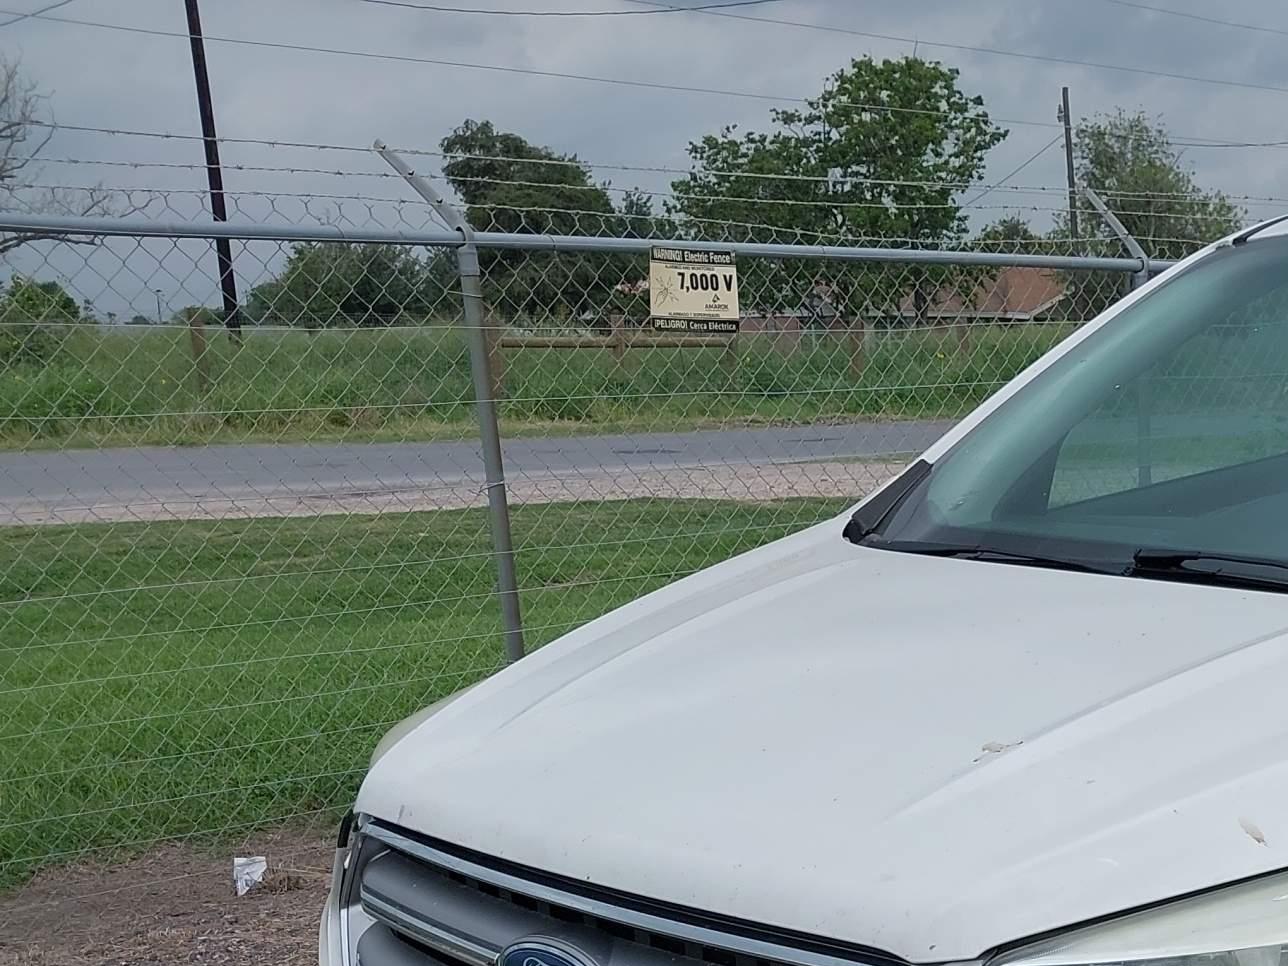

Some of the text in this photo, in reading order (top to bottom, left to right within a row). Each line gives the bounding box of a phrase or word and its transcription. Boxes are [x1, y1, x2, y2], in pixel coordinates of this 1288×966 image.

[684, 251, 709, 263] Electric
[710, 252, 731, 264] Fence
[677, 271, 733, 293] 7,000 V
[689, 321, 707, 330] Cerca
[708, 320, 737, 331] Eléctrica
